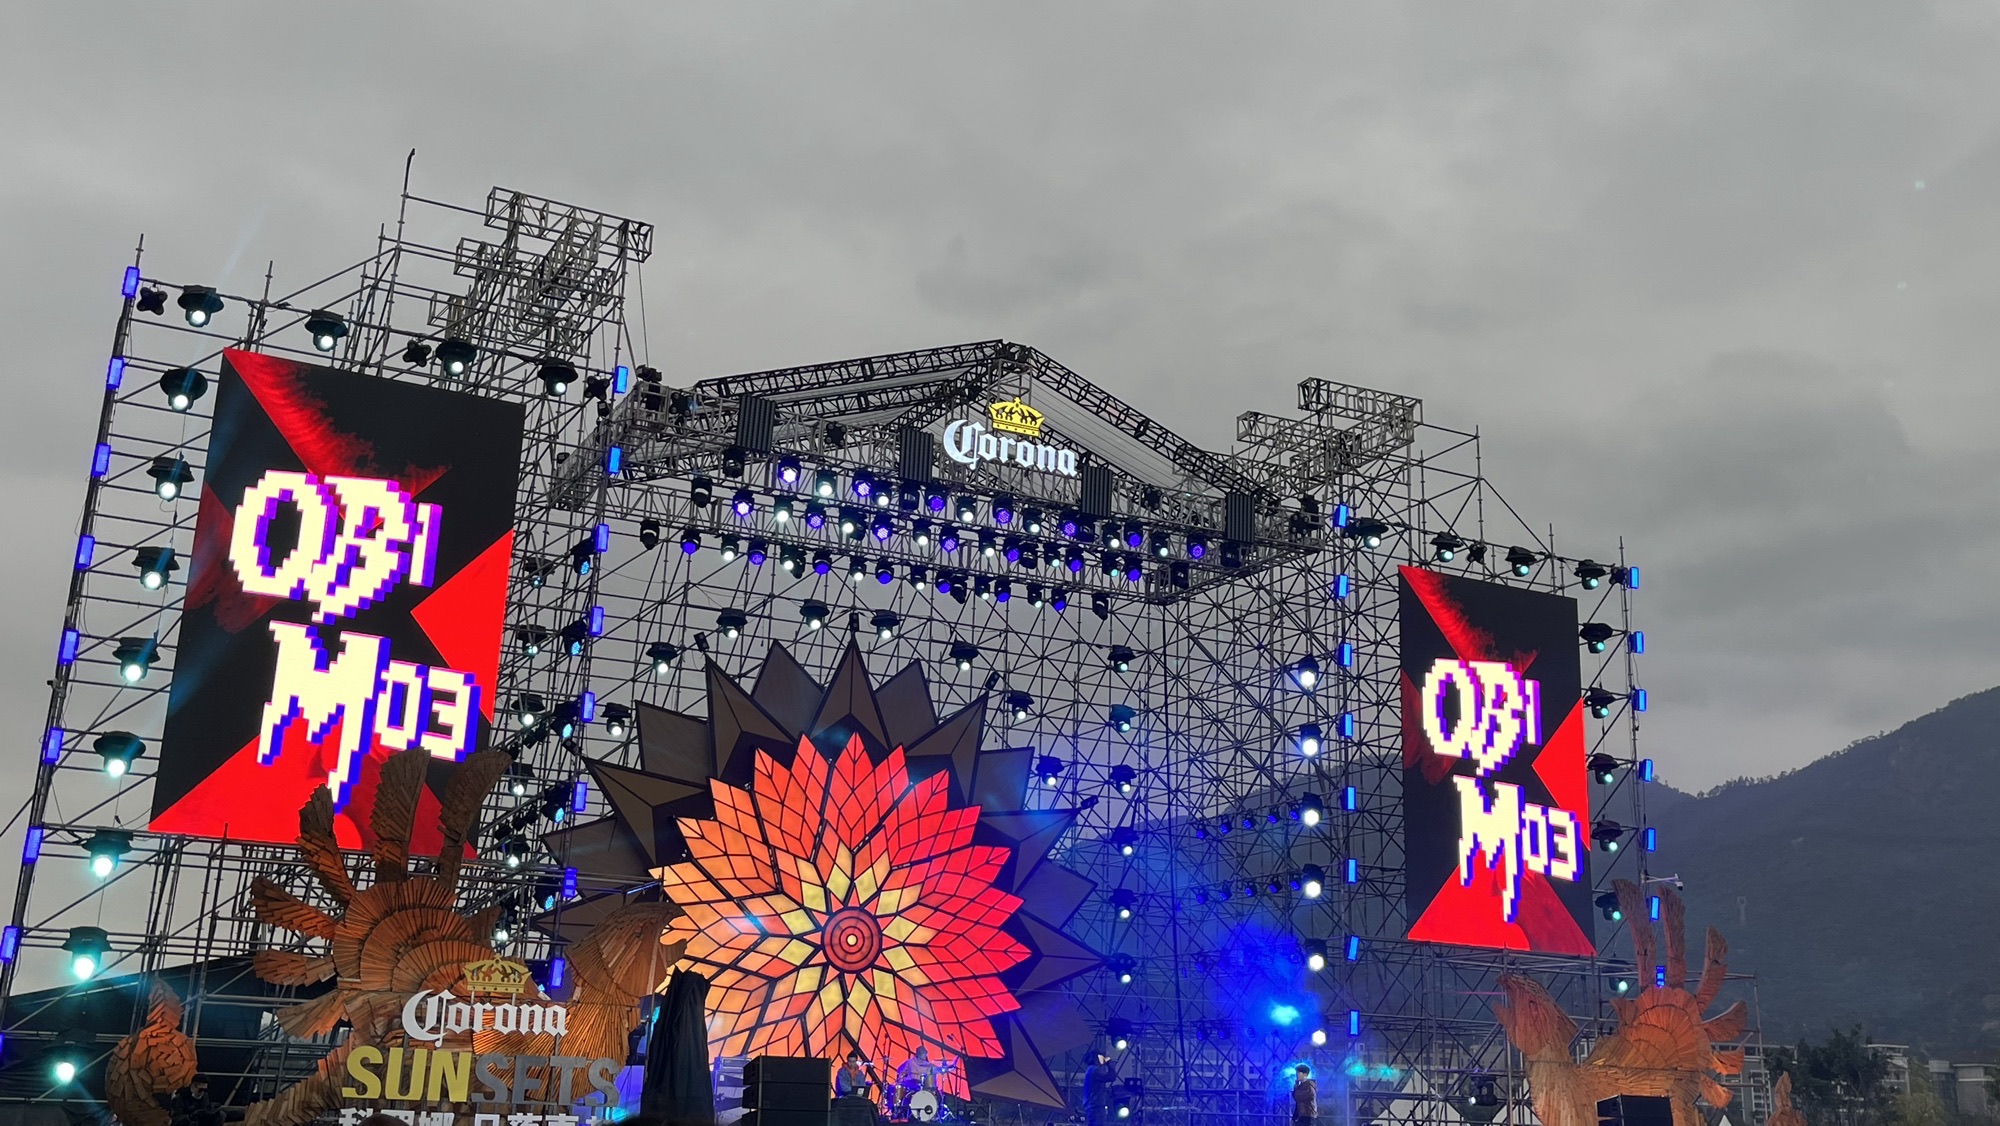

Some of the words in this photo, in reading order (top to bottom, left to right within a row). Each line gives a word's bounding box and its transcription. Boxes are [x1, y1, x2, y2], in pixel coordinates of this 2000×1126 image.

[943, 419, 1078, 476] Corona
[402, 988, 569, 1047] Corona
[341, 1045, 621, 1108] SUNSETS
